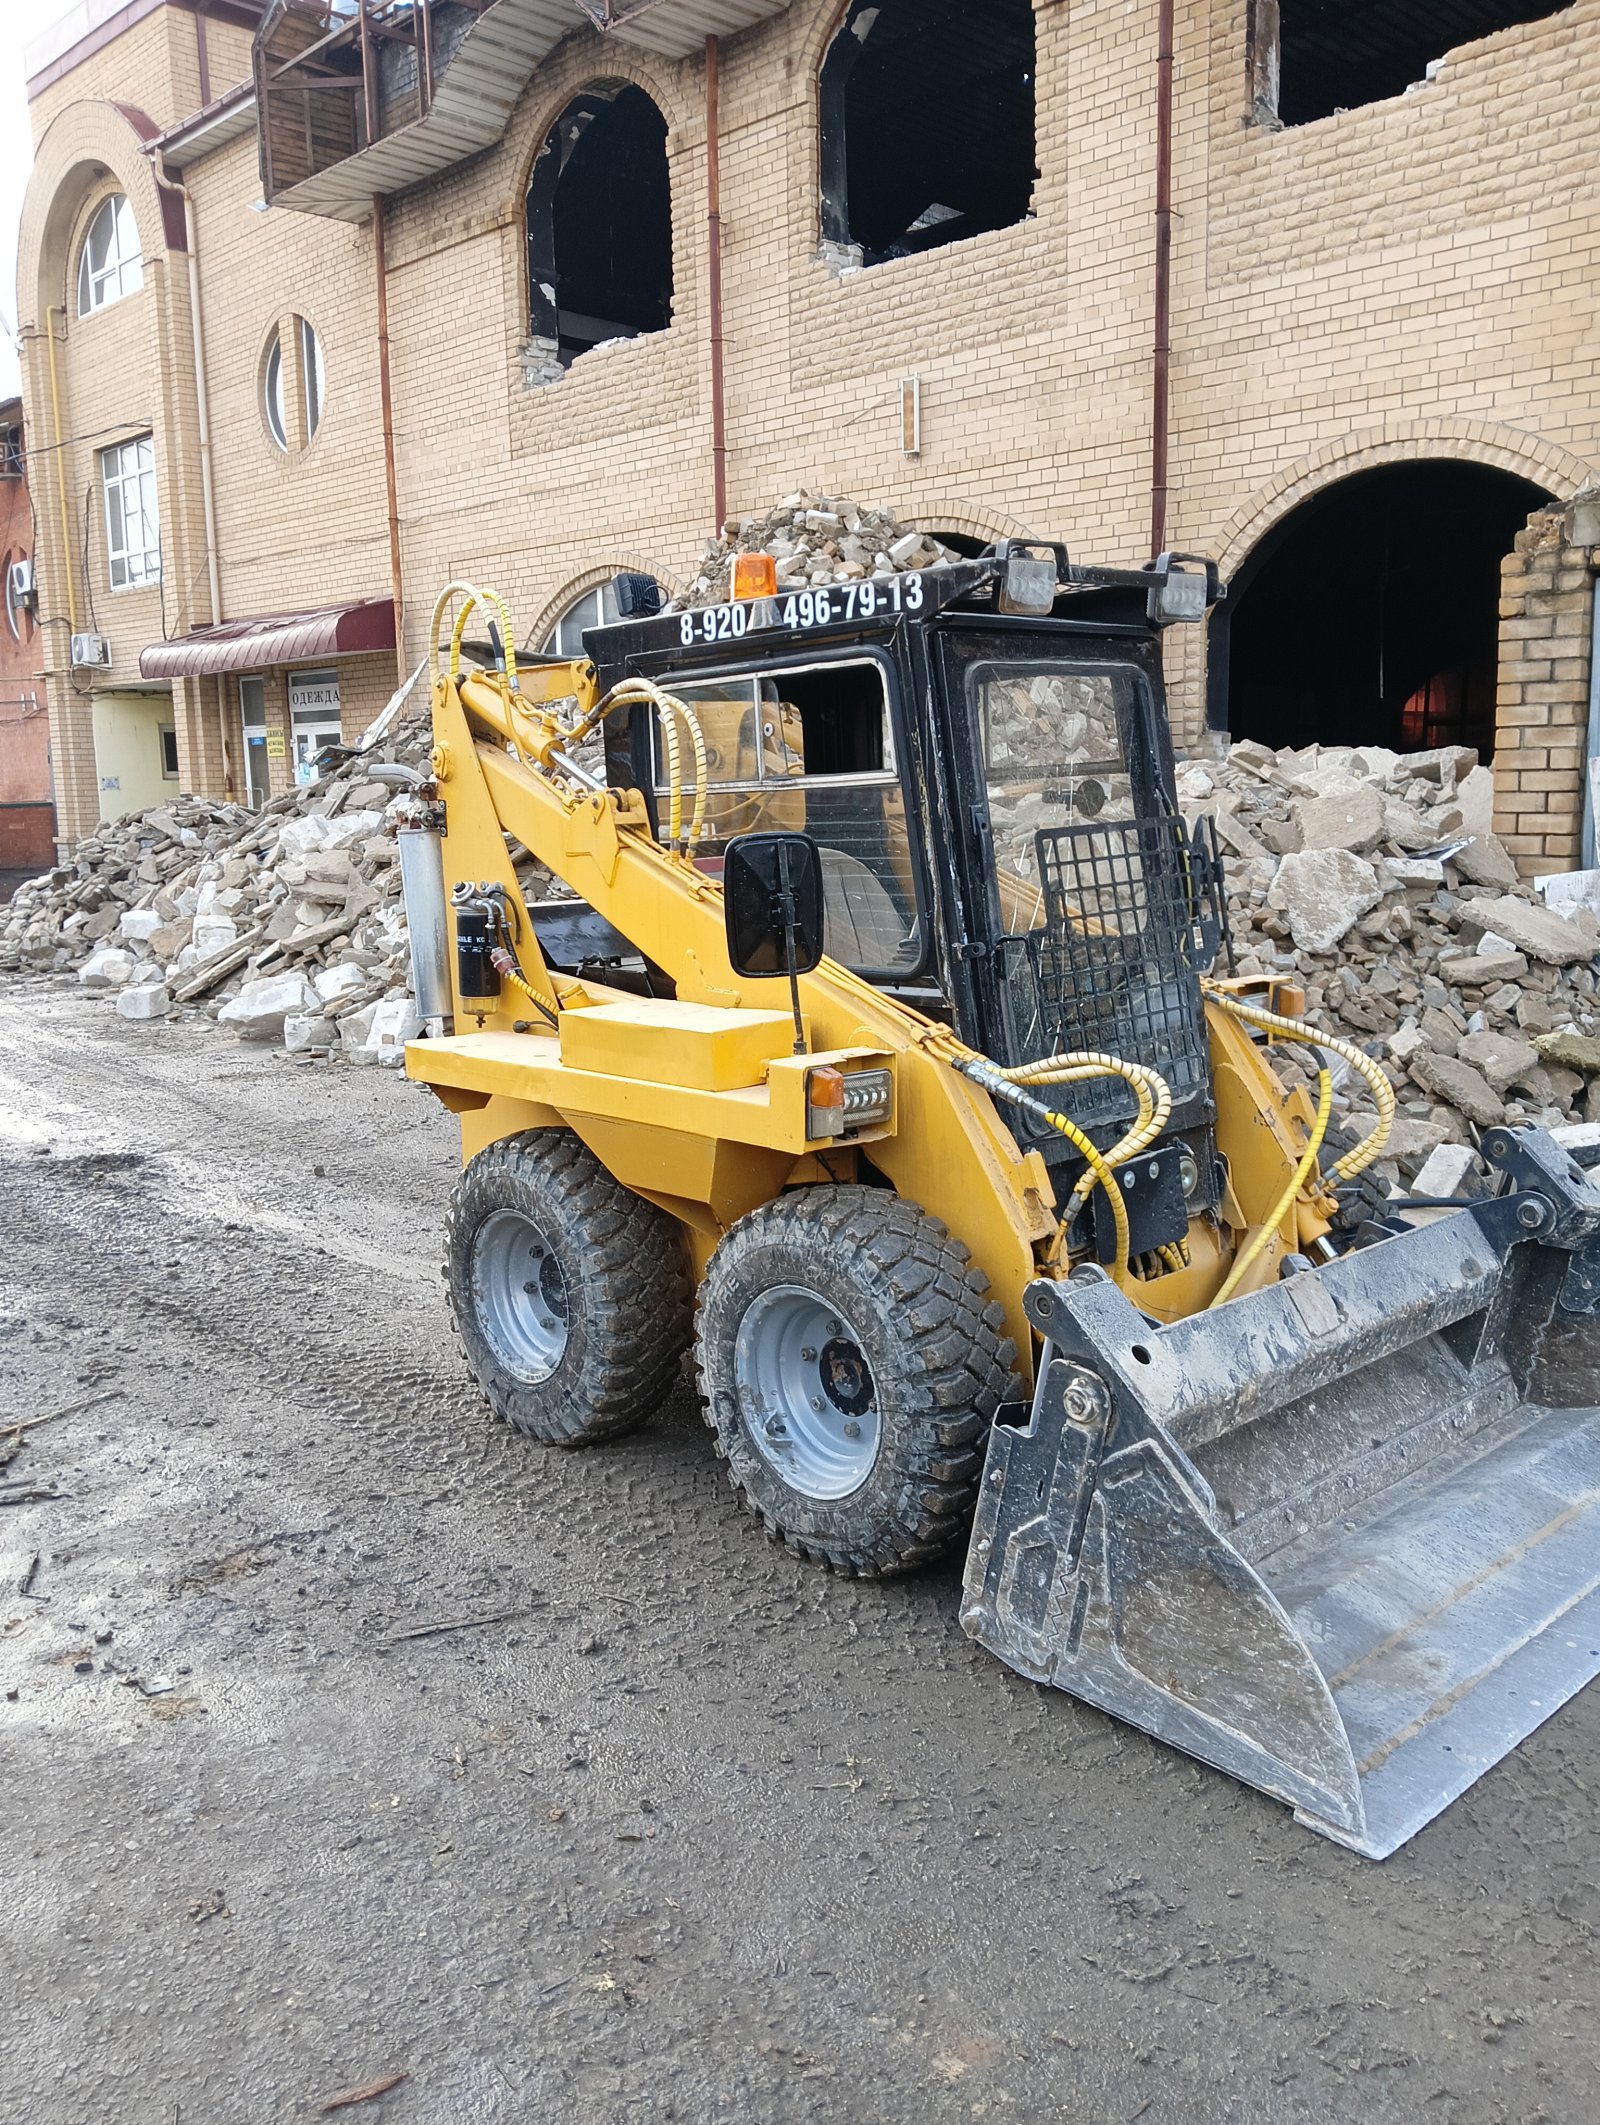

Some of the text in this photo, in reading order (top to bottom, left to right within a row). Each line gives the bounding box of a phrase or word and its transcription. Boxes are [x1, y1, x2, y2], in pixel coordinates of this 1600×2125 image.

[680, 572, 924, 645] 8-920 496-79-13
[292, 690, 340, 705] ОДЕЖДА
